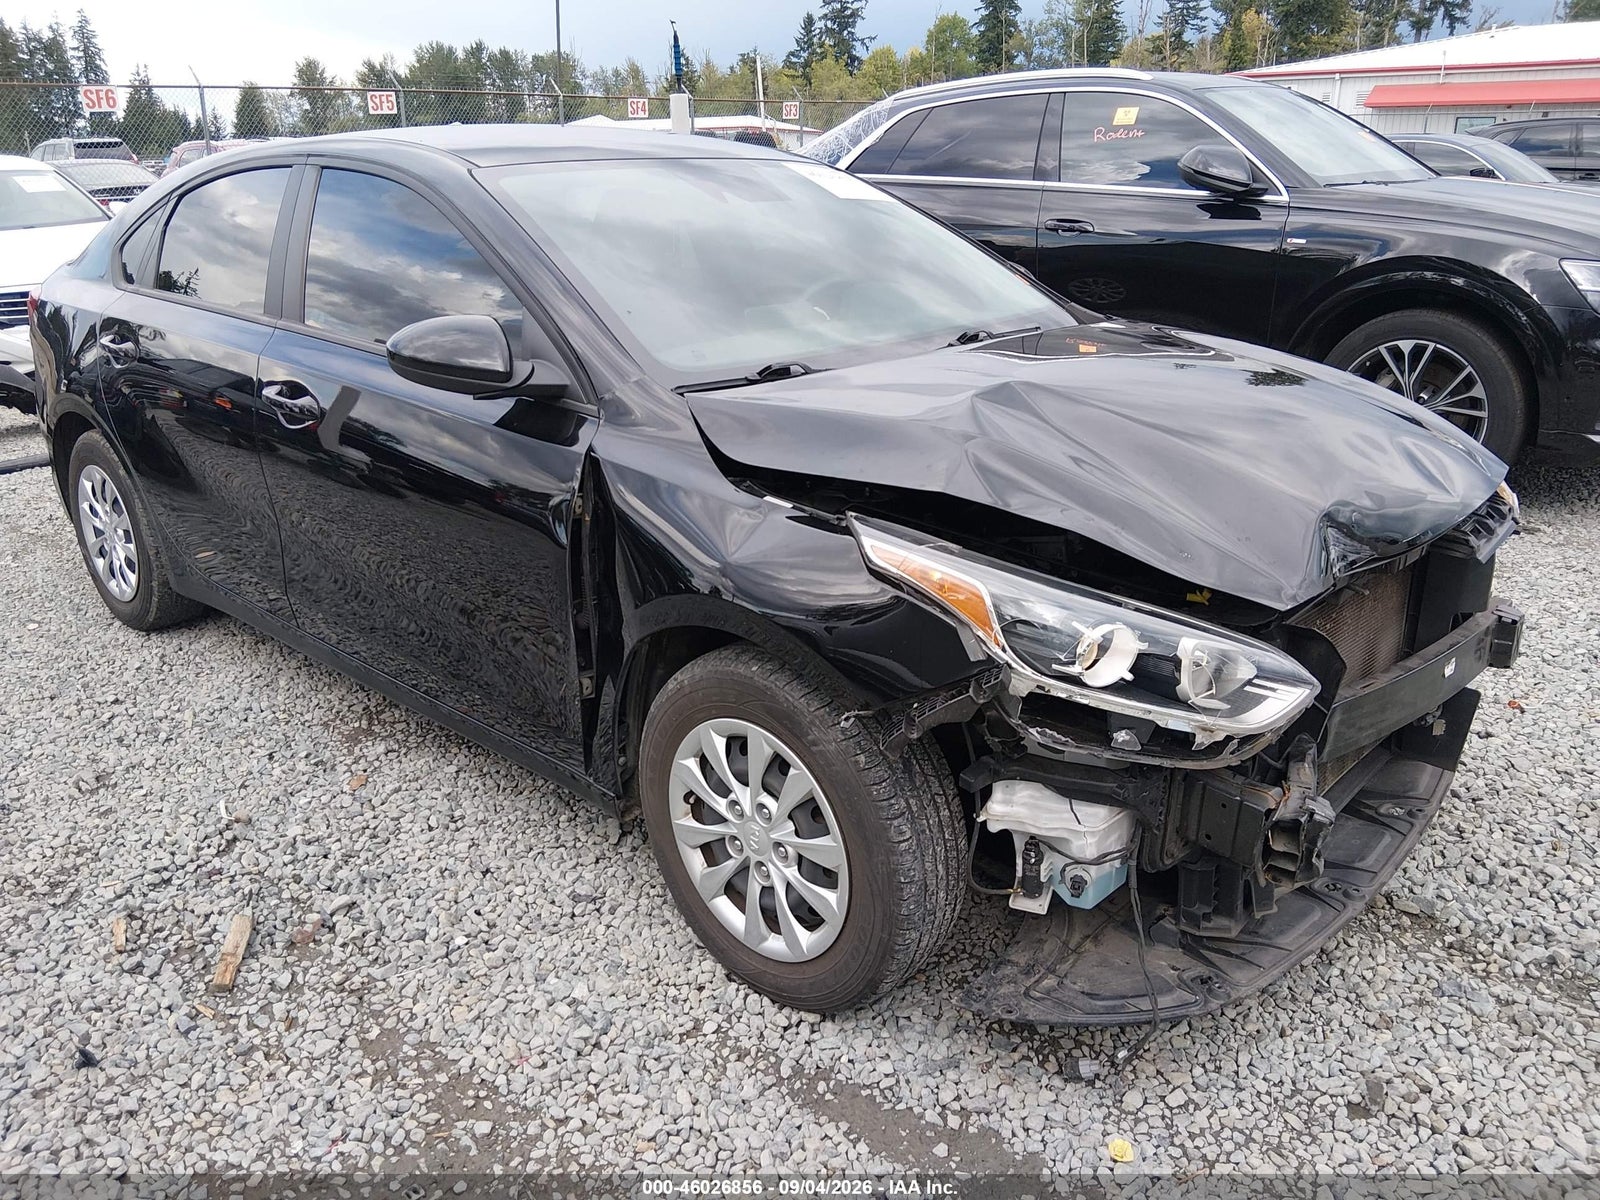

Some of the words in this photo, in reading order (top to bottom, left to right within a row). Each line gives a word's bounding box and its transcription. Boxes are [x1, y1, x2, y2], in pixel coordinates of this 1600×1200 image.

[83, 88, 118, 109] SF6
[370, 94, 395, 111] SF5
[630, 100, 647, 115] SF4
[784, 103, 798, 117] SF3
